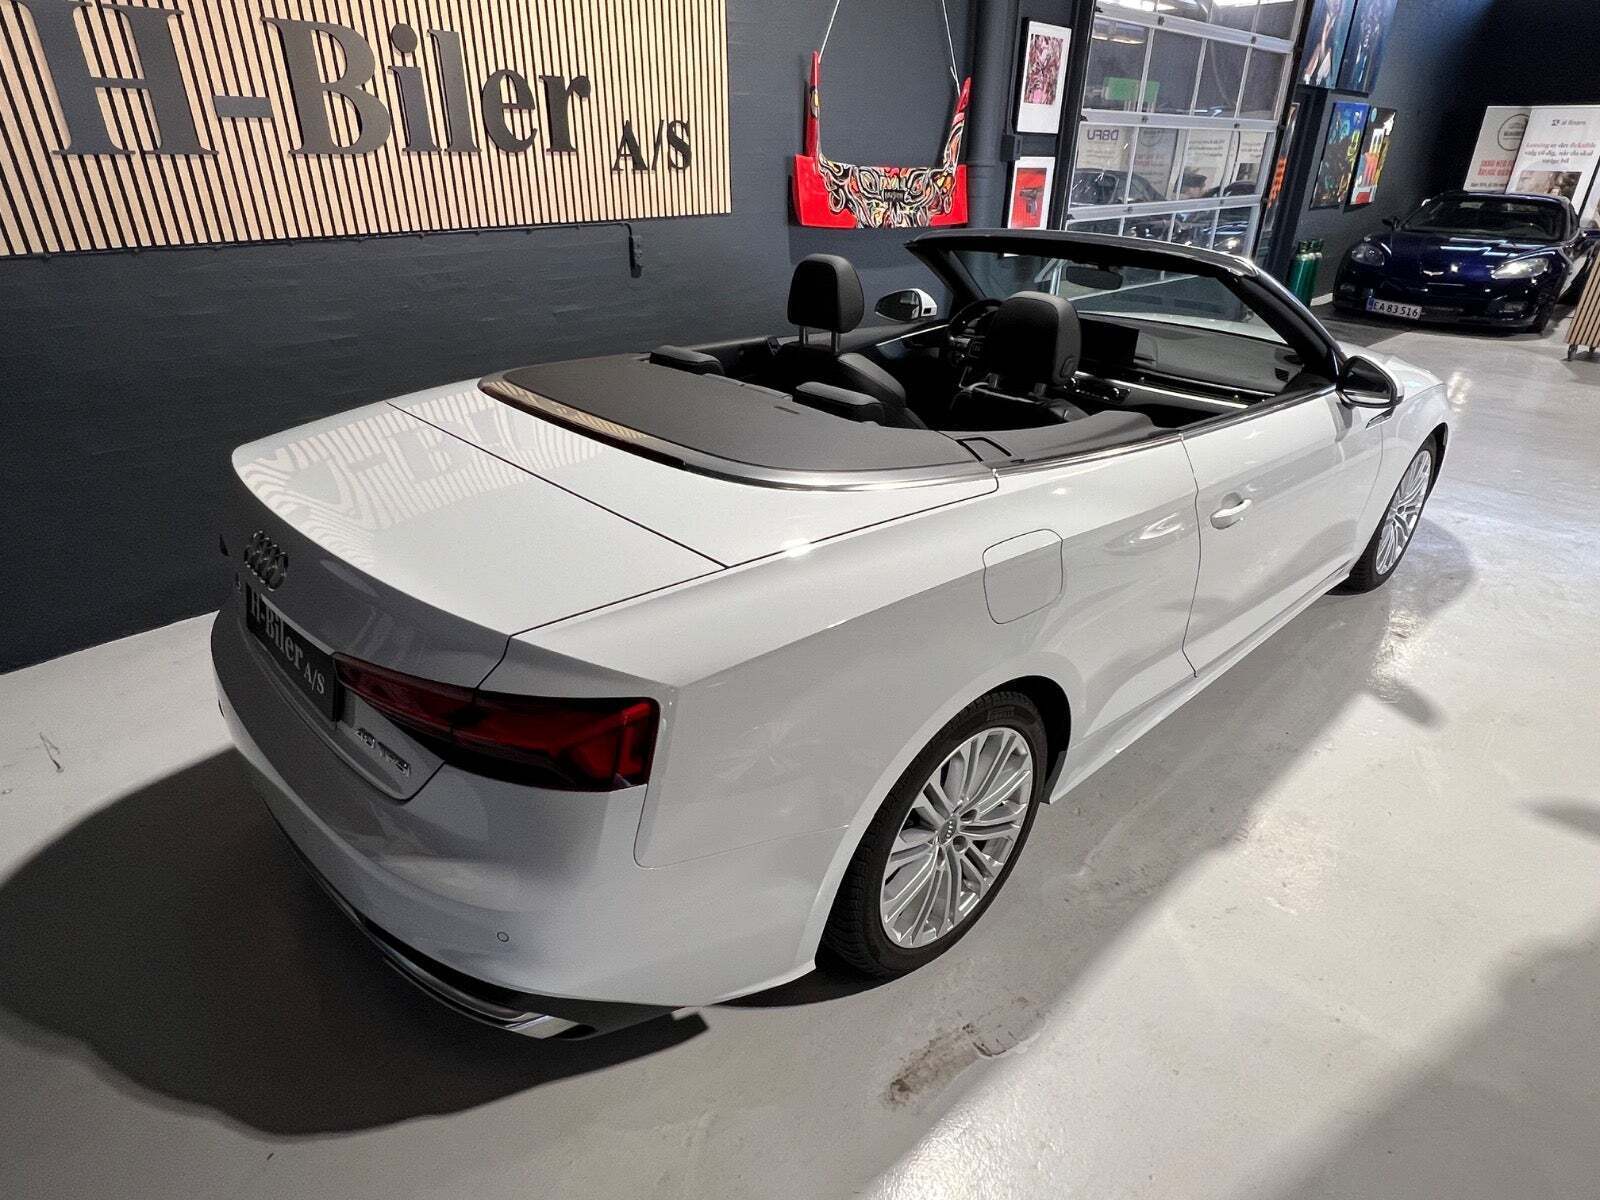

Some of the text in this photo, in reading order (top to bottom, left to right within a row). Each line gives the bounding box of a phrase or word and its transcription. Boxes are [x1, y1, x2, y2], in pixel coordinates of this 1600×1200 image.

[8, 0, 692, 171] H-Biler A/S
[1386, 304, 1399, 314] 83
[1400, 306, 1419, 317] 516
[303, 661, 326, 694] A/S
